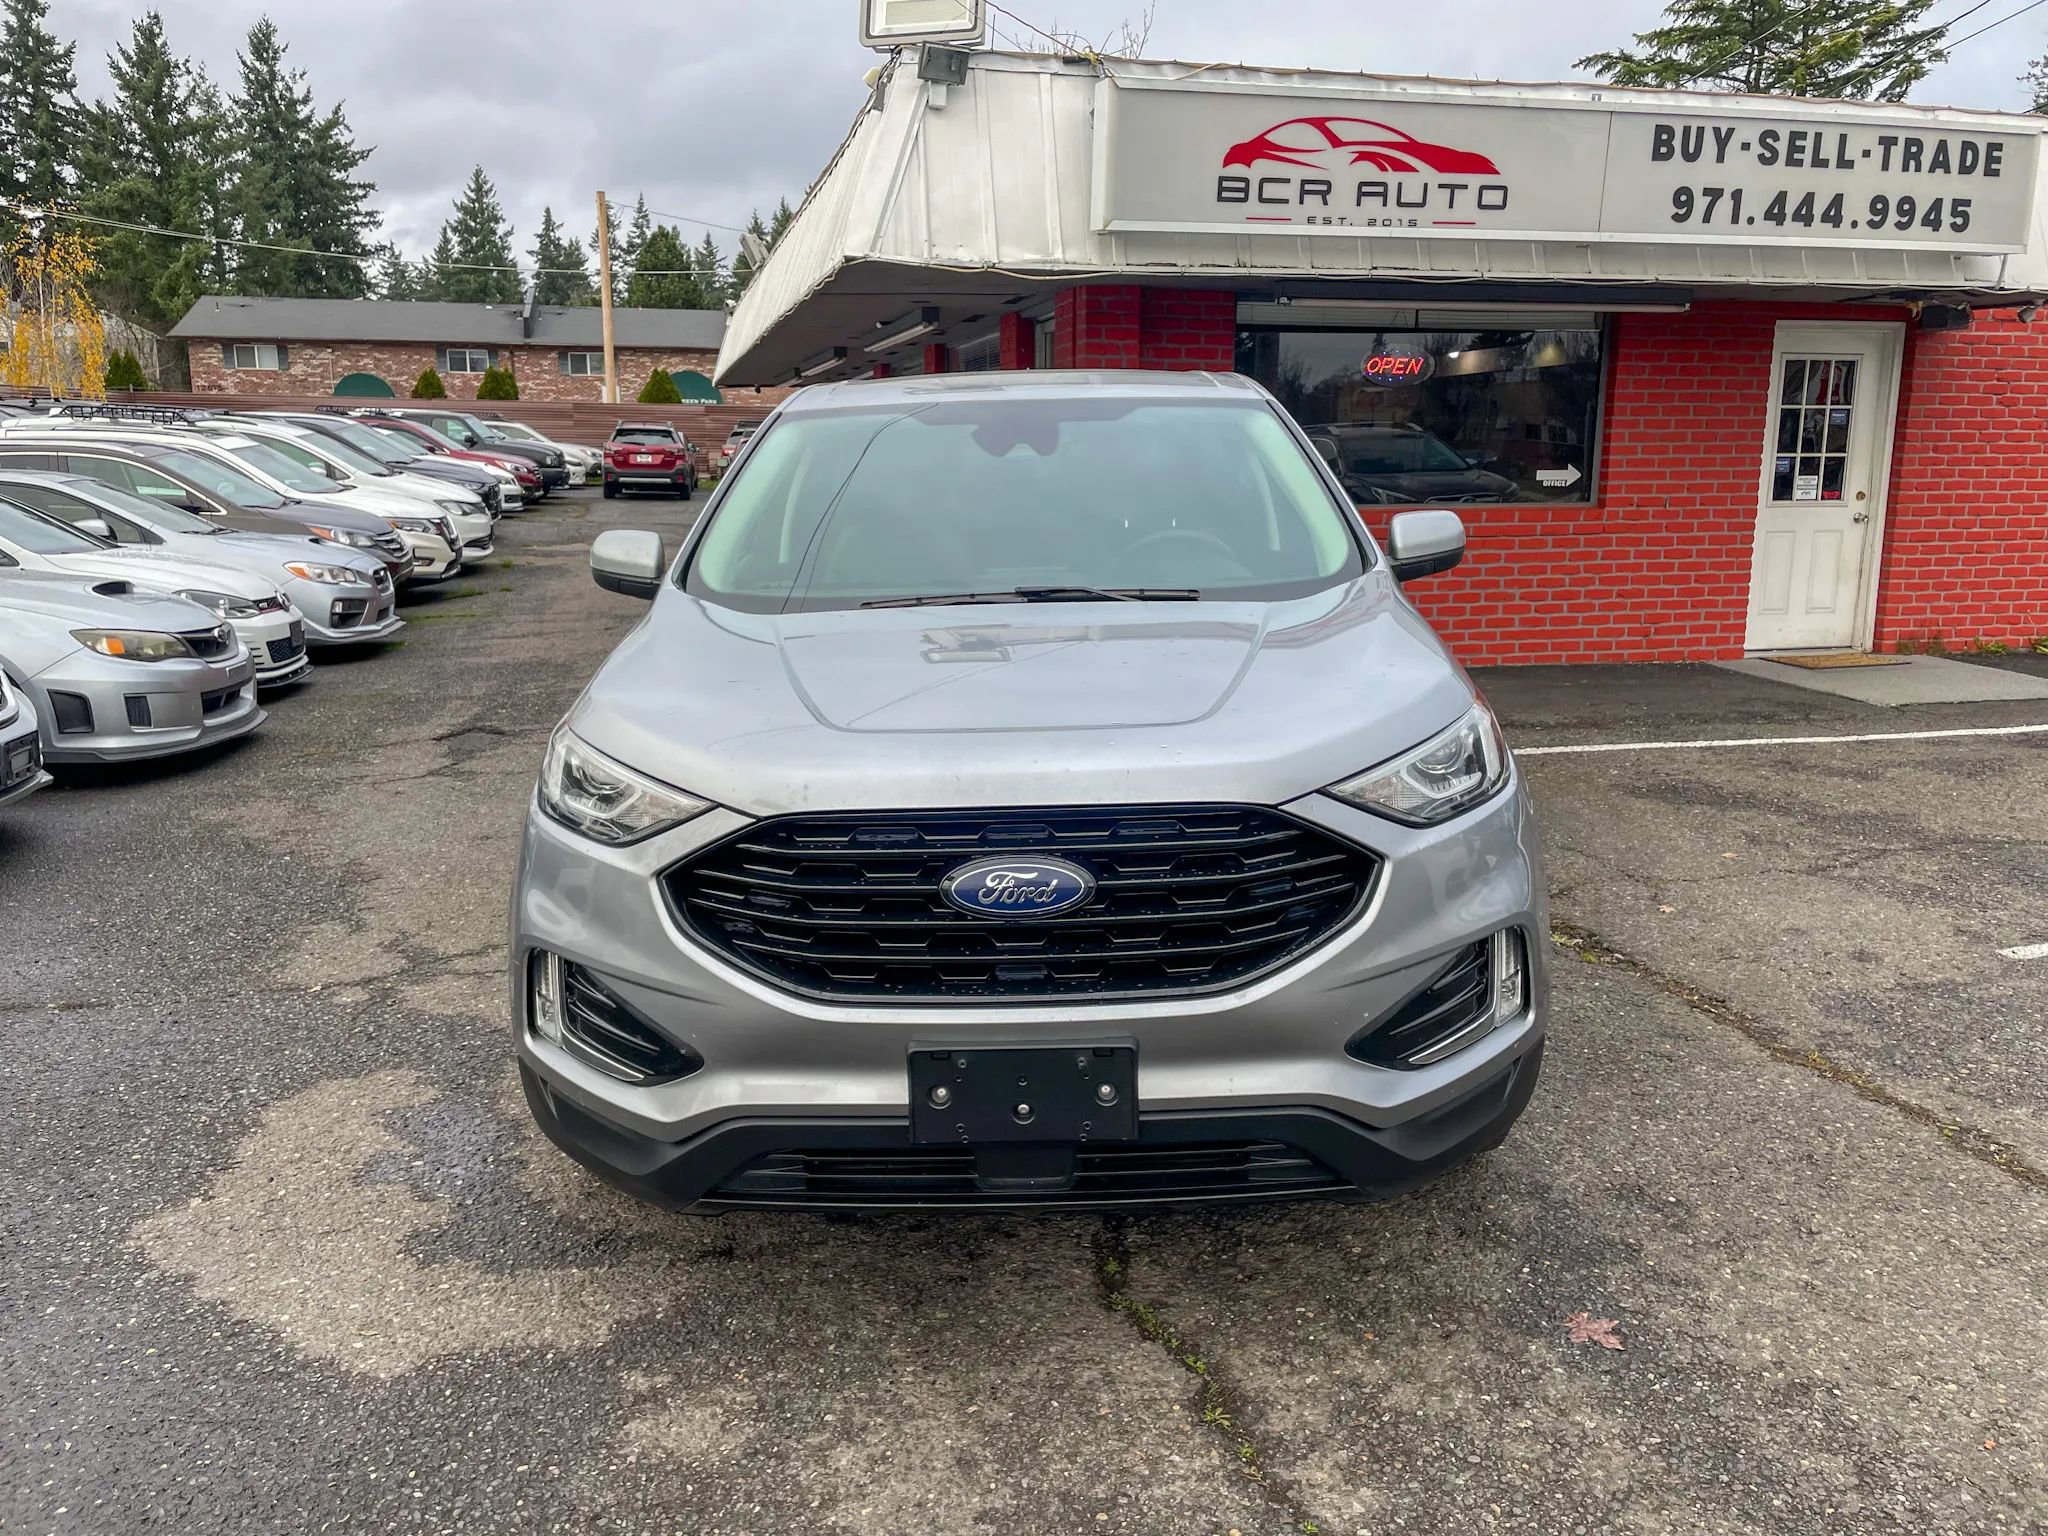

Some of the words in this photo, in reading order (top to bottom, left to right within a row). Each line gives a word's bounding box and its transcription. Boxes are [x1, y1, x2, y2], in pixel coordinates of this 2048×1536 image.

[1651, 124, 2004, 177] BUY-SELL-TRADE
[1217, 176, 1331, 206] BCR
[1356, 181, 1508, 210] AUTO
[1670, 186, 1972, 233] 971.444.9945
[1307, 216, 1353, 226] EST.
[1368, 218, 1418, 227] 2015
[1366, 357, 1424, 374] OPEN
[978, 871, 1059, 904] Ford
